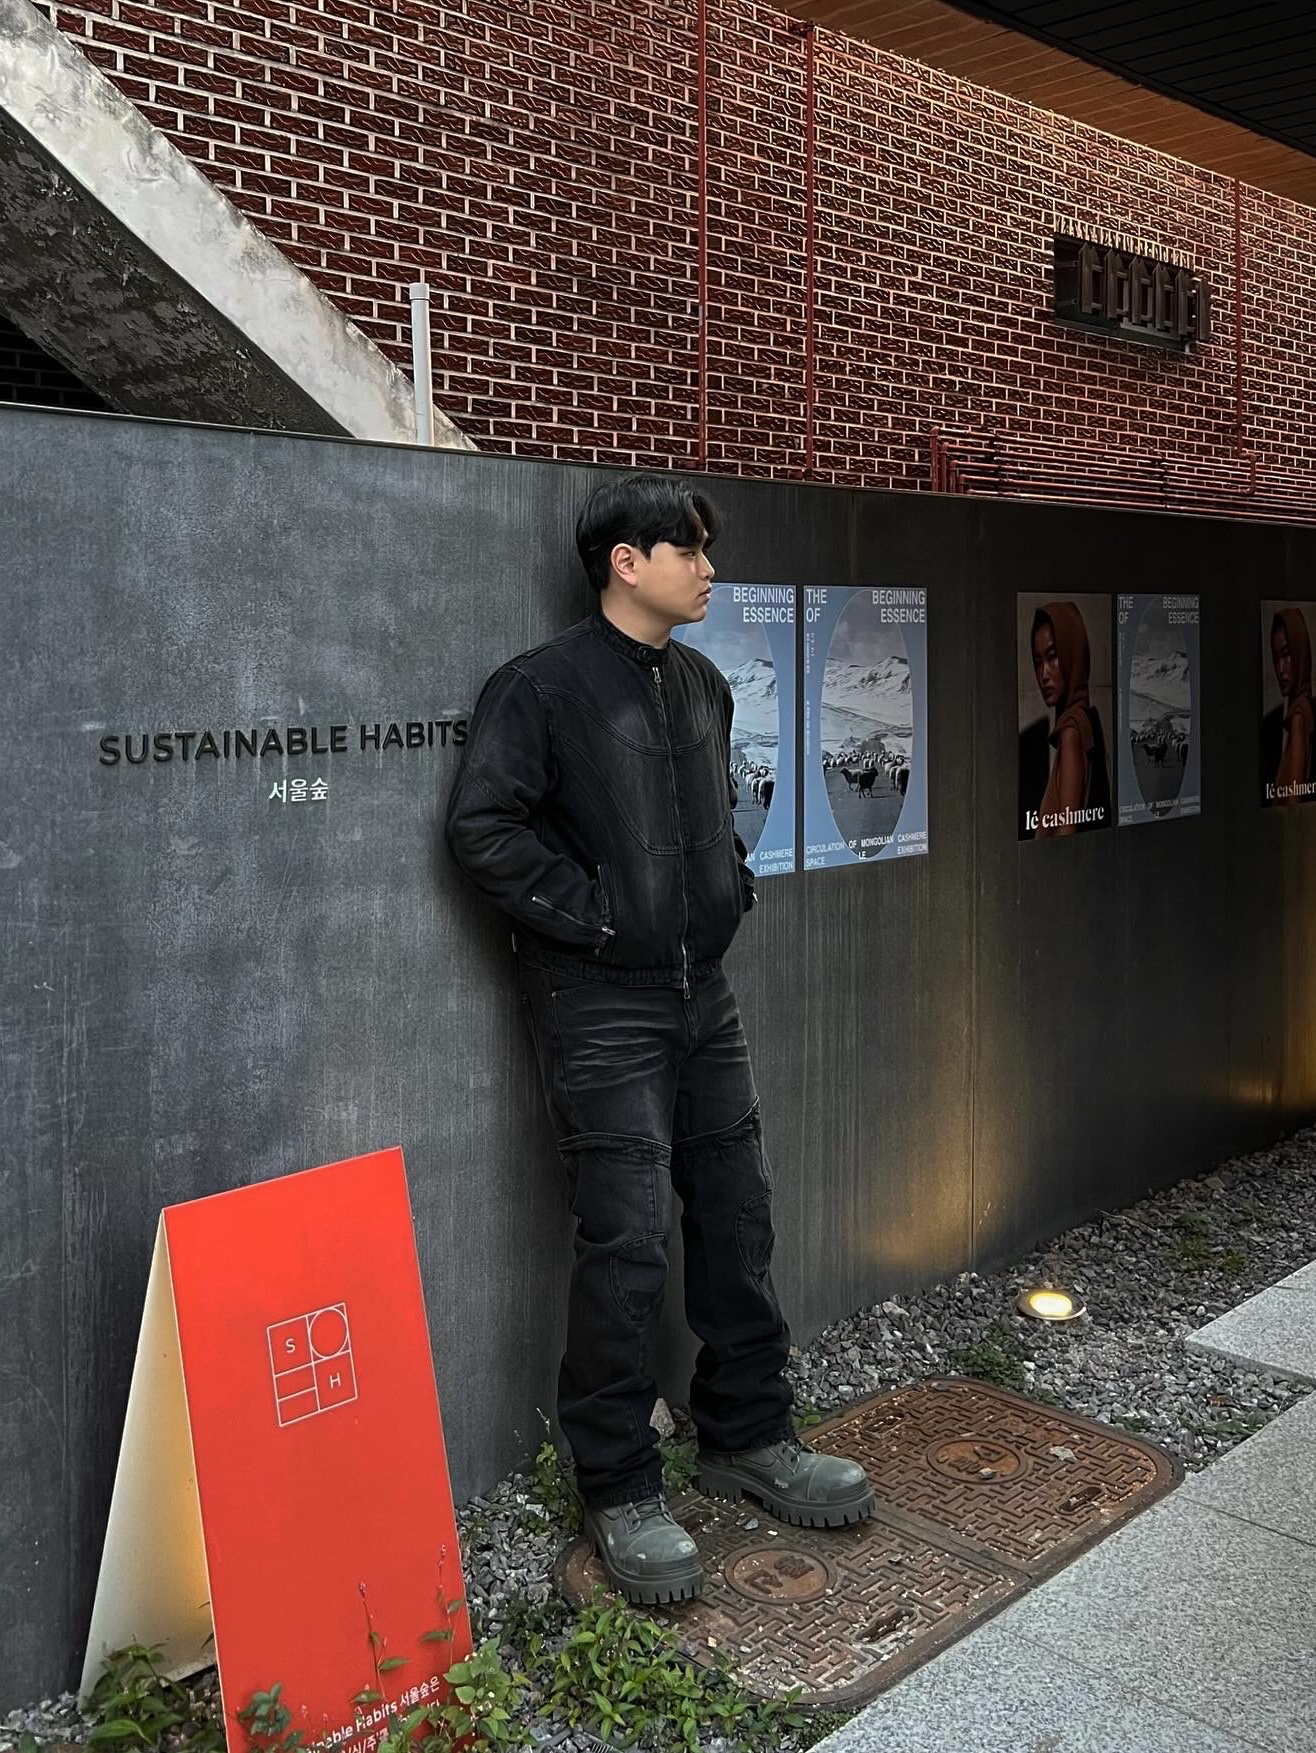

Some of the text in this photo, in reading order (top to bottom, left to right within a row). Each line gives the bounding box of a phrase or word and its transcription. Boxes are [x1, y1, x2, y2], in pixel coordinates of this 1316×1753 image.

[733, 586, 794, 604] BEGINNING
[806, 588, 925, 605] THE BEGINNING
[1119, 596, 1199, 609] THE BEGINNING
[742, 607, 794, 623] ESSENCE
[806, 607, 926, 623] OF ESSENCE
[1119, 611, 1199, 625] OF ESSENCE
[99, 719, 468, 765] SUSTAINABLE HABITS
[268, 776, 329, 803] 서울숲
[1025, 809, 1039, 831] lé
[1042, 804, 1105, 829] cashmere
[806, 831, 927, 855] CIRCULATION OF MONGOLIAN CASHMERE
[805, 856, 826, 867] SPACE
[355, 1701, 398, 1732] Habits
[400, 1675, 440, 1706] 서울숲은
